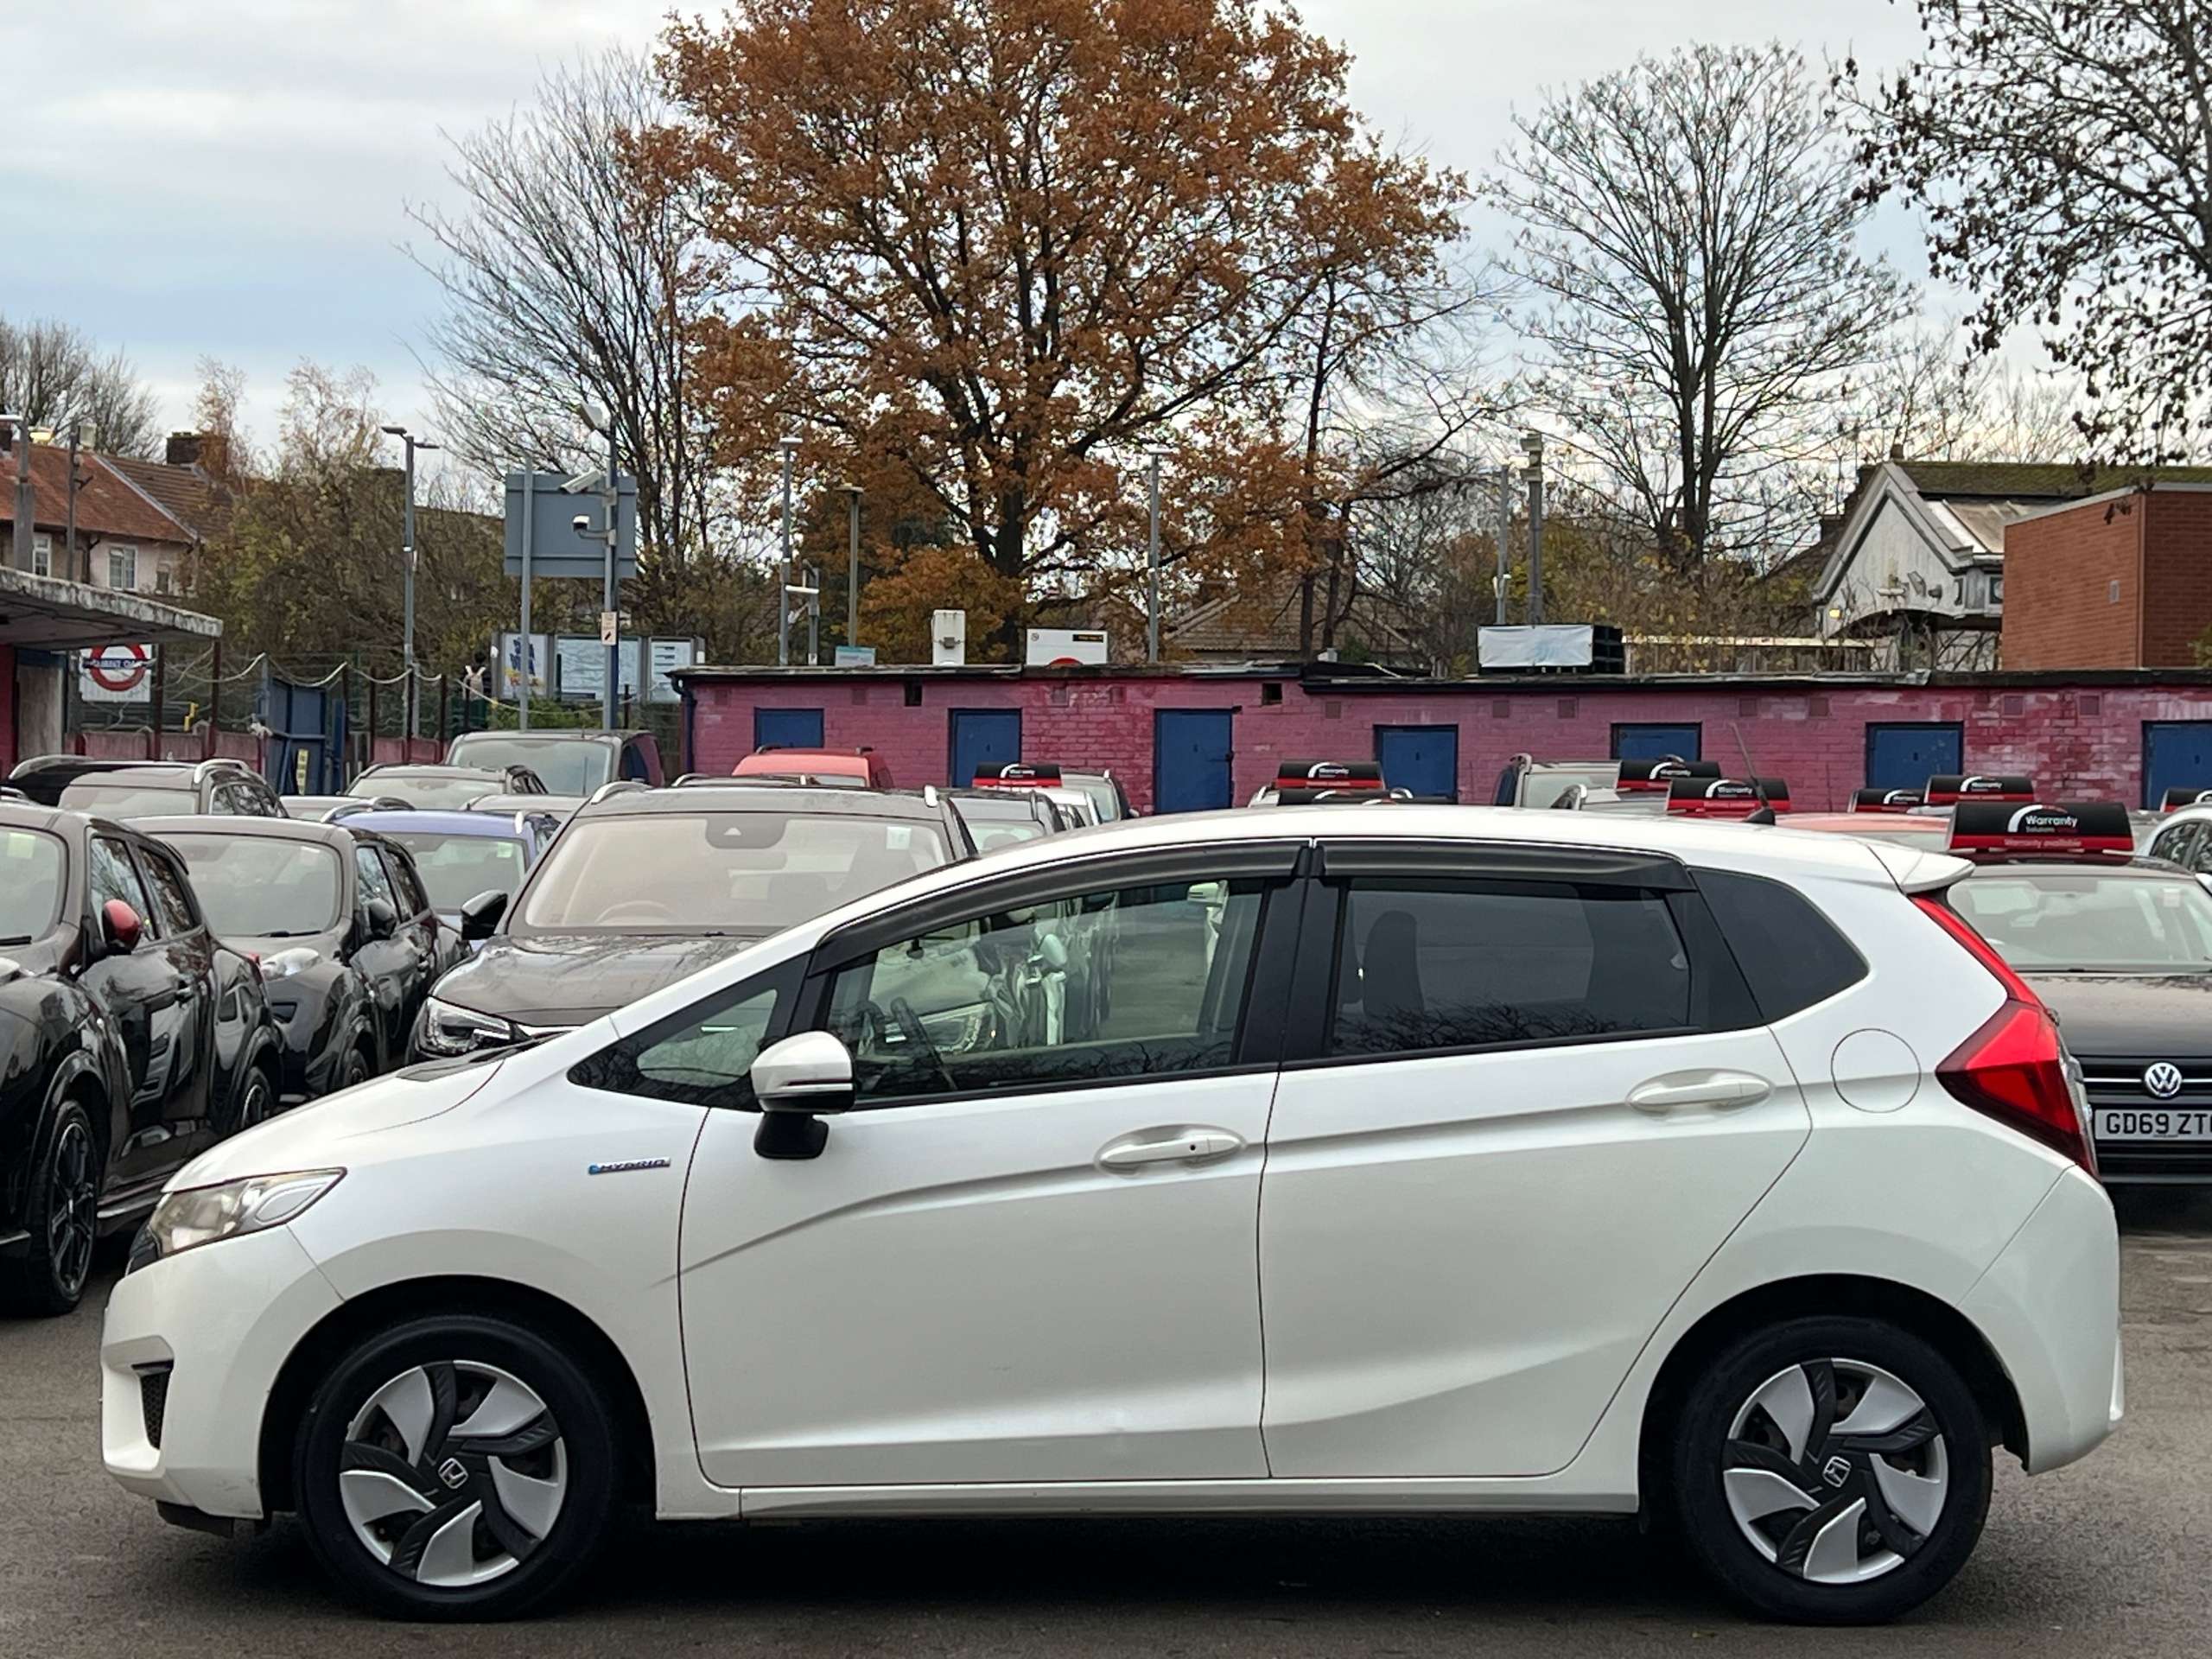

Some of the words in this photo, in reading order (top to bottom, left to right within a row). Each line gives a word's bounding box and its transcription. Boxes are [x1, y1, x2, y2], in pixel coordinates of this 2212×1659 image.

[1717, 785, 1753, 795] Warranty
[2024, 815, 2078, 828] Warranty
[2004, 837, 2042, 849] Warranty
[2106, 1112, 2171, 1135] GD69
[2177, 1112, 2212, 1135] ZT
[599, 1159, 666, 1172] HYBRID
